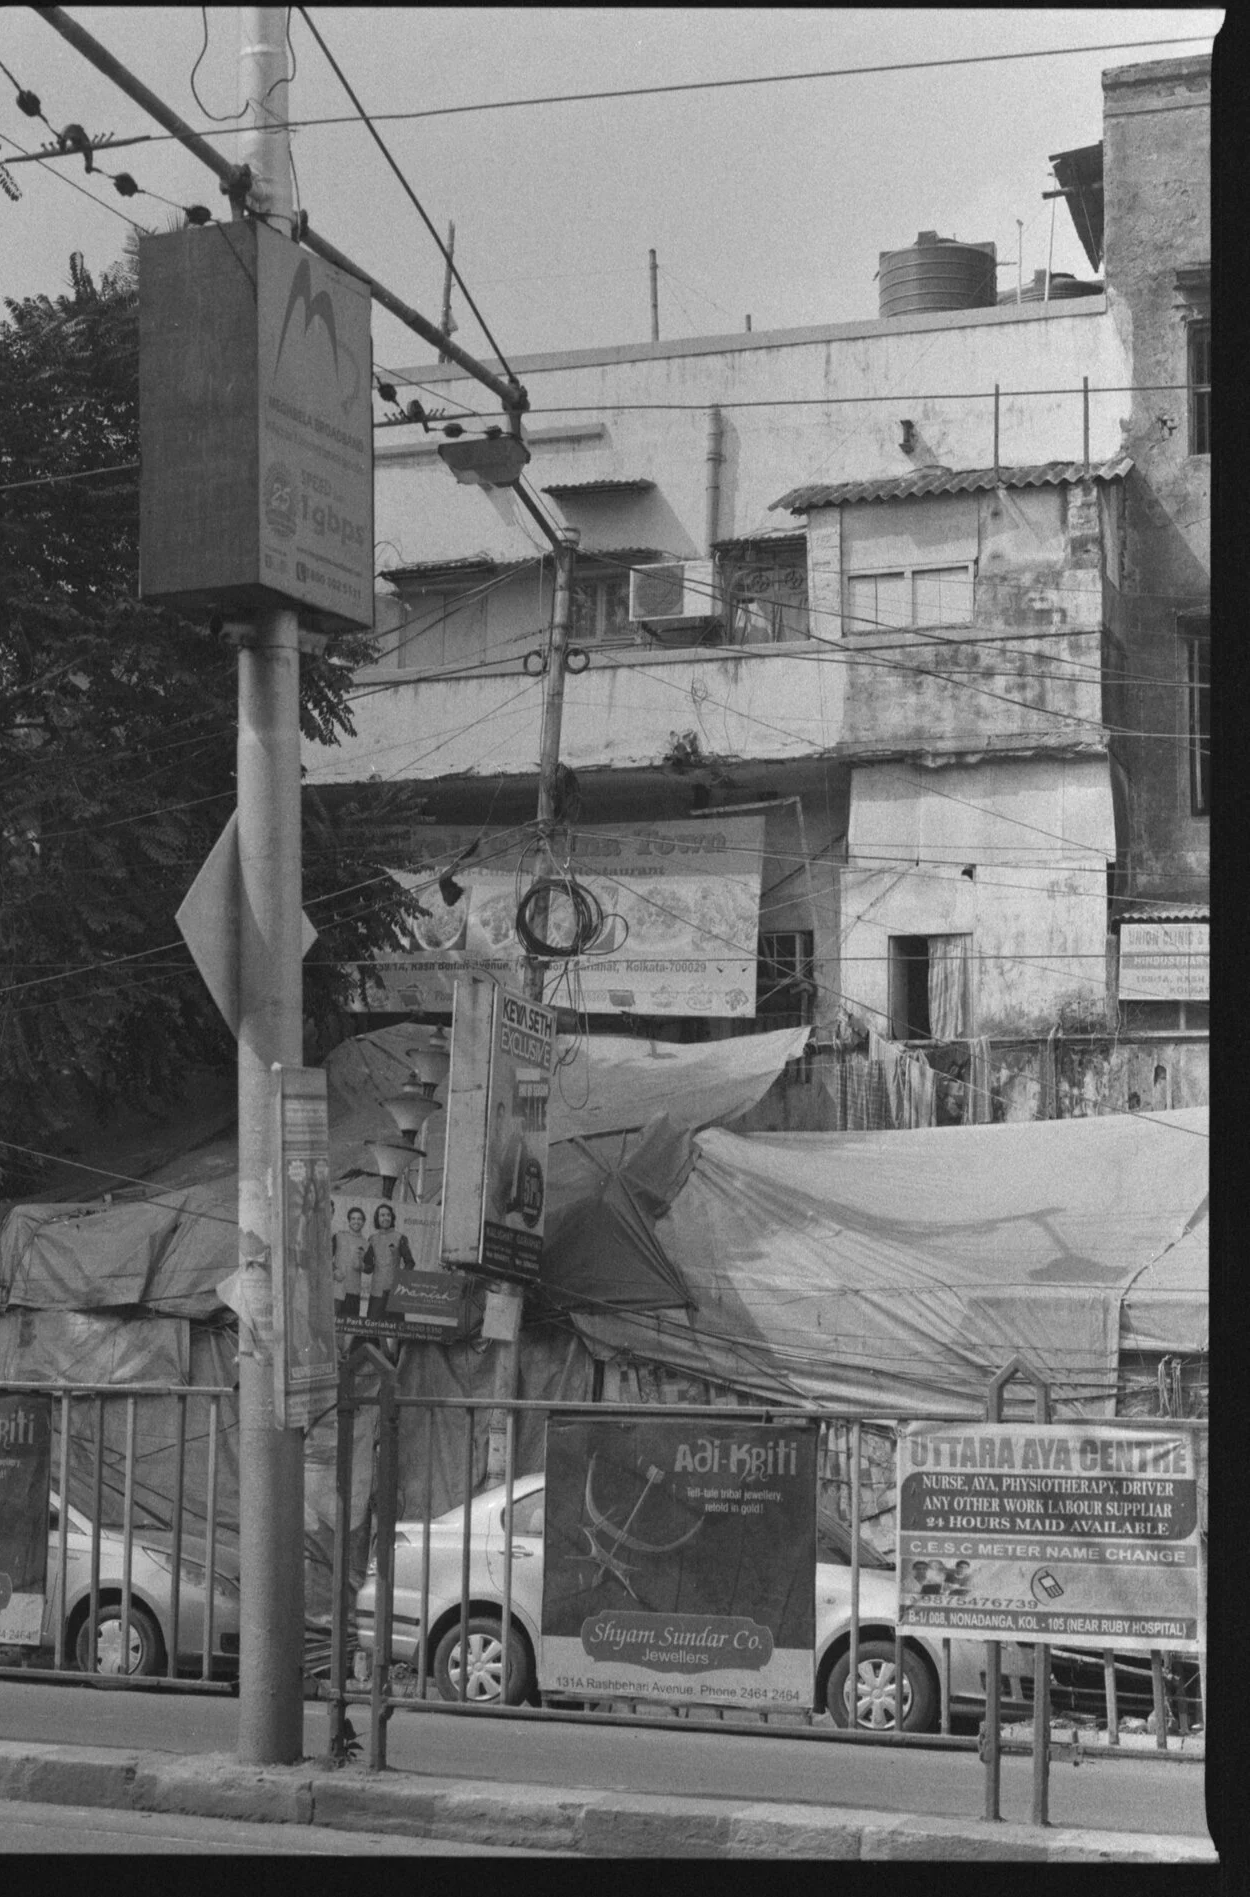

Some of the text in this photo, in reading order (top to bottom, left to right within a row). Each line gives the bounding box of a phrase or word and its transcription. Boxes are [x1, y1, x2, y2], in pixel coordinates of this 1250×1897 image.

[634, 829, 728, 856] Town
[626, 961, 707, 973] Kolkata-700029
[345, 1317, 363, 1326] Park
[364, 1319, 397, 1330] Gariahat
[909, 1435, 1188, 1474] UTTARA AYA CENTRE
[720, 1488, 742, 1499] tribal
[922, 1474, 1175, 1497] NURSE, AYA, PHYSIOTHERAPY, DRIVER
[730, 1503, 739, 1513] in
[740, 1502, 764, 1515] gold!
[922, 1495, 1173, 1518] ANY OTHER WORK LABOUR SUPPLIAR
[925, 1515, 1170, 1536] 24 HOURS MAID AVAILABLE
[978, 1544, 1041, 1558] METER
[1046, 1546, 1101, 1561] NAME
[1105, 1548, 1187, 1564] CHANGE
[589, 1621, 763, 1650] Shyam Sundar Co.
[949, 1612, 1017, 1630] NONADANGA,
[1018, 1615, 1039, 1630] KOL
[1048, 1617, 1065, 1631] 105
[1066, 1617, 1099, 1633] (NEAR
[1101, 1619, 1131, 1634] RUBY
[1132, 1620, 1187, 1638] HOSPITAL)
[641, 1648, 710, 1666] Jewellers
[555, 1676, 584, 1688] 131A
[586, 1677, 650, 1693] Rashbehari
[700, 1684, 738, 1698] Phone
[739, 1686, 768, 1699] 2464
[770, 1688, 800, 1702] 2464
